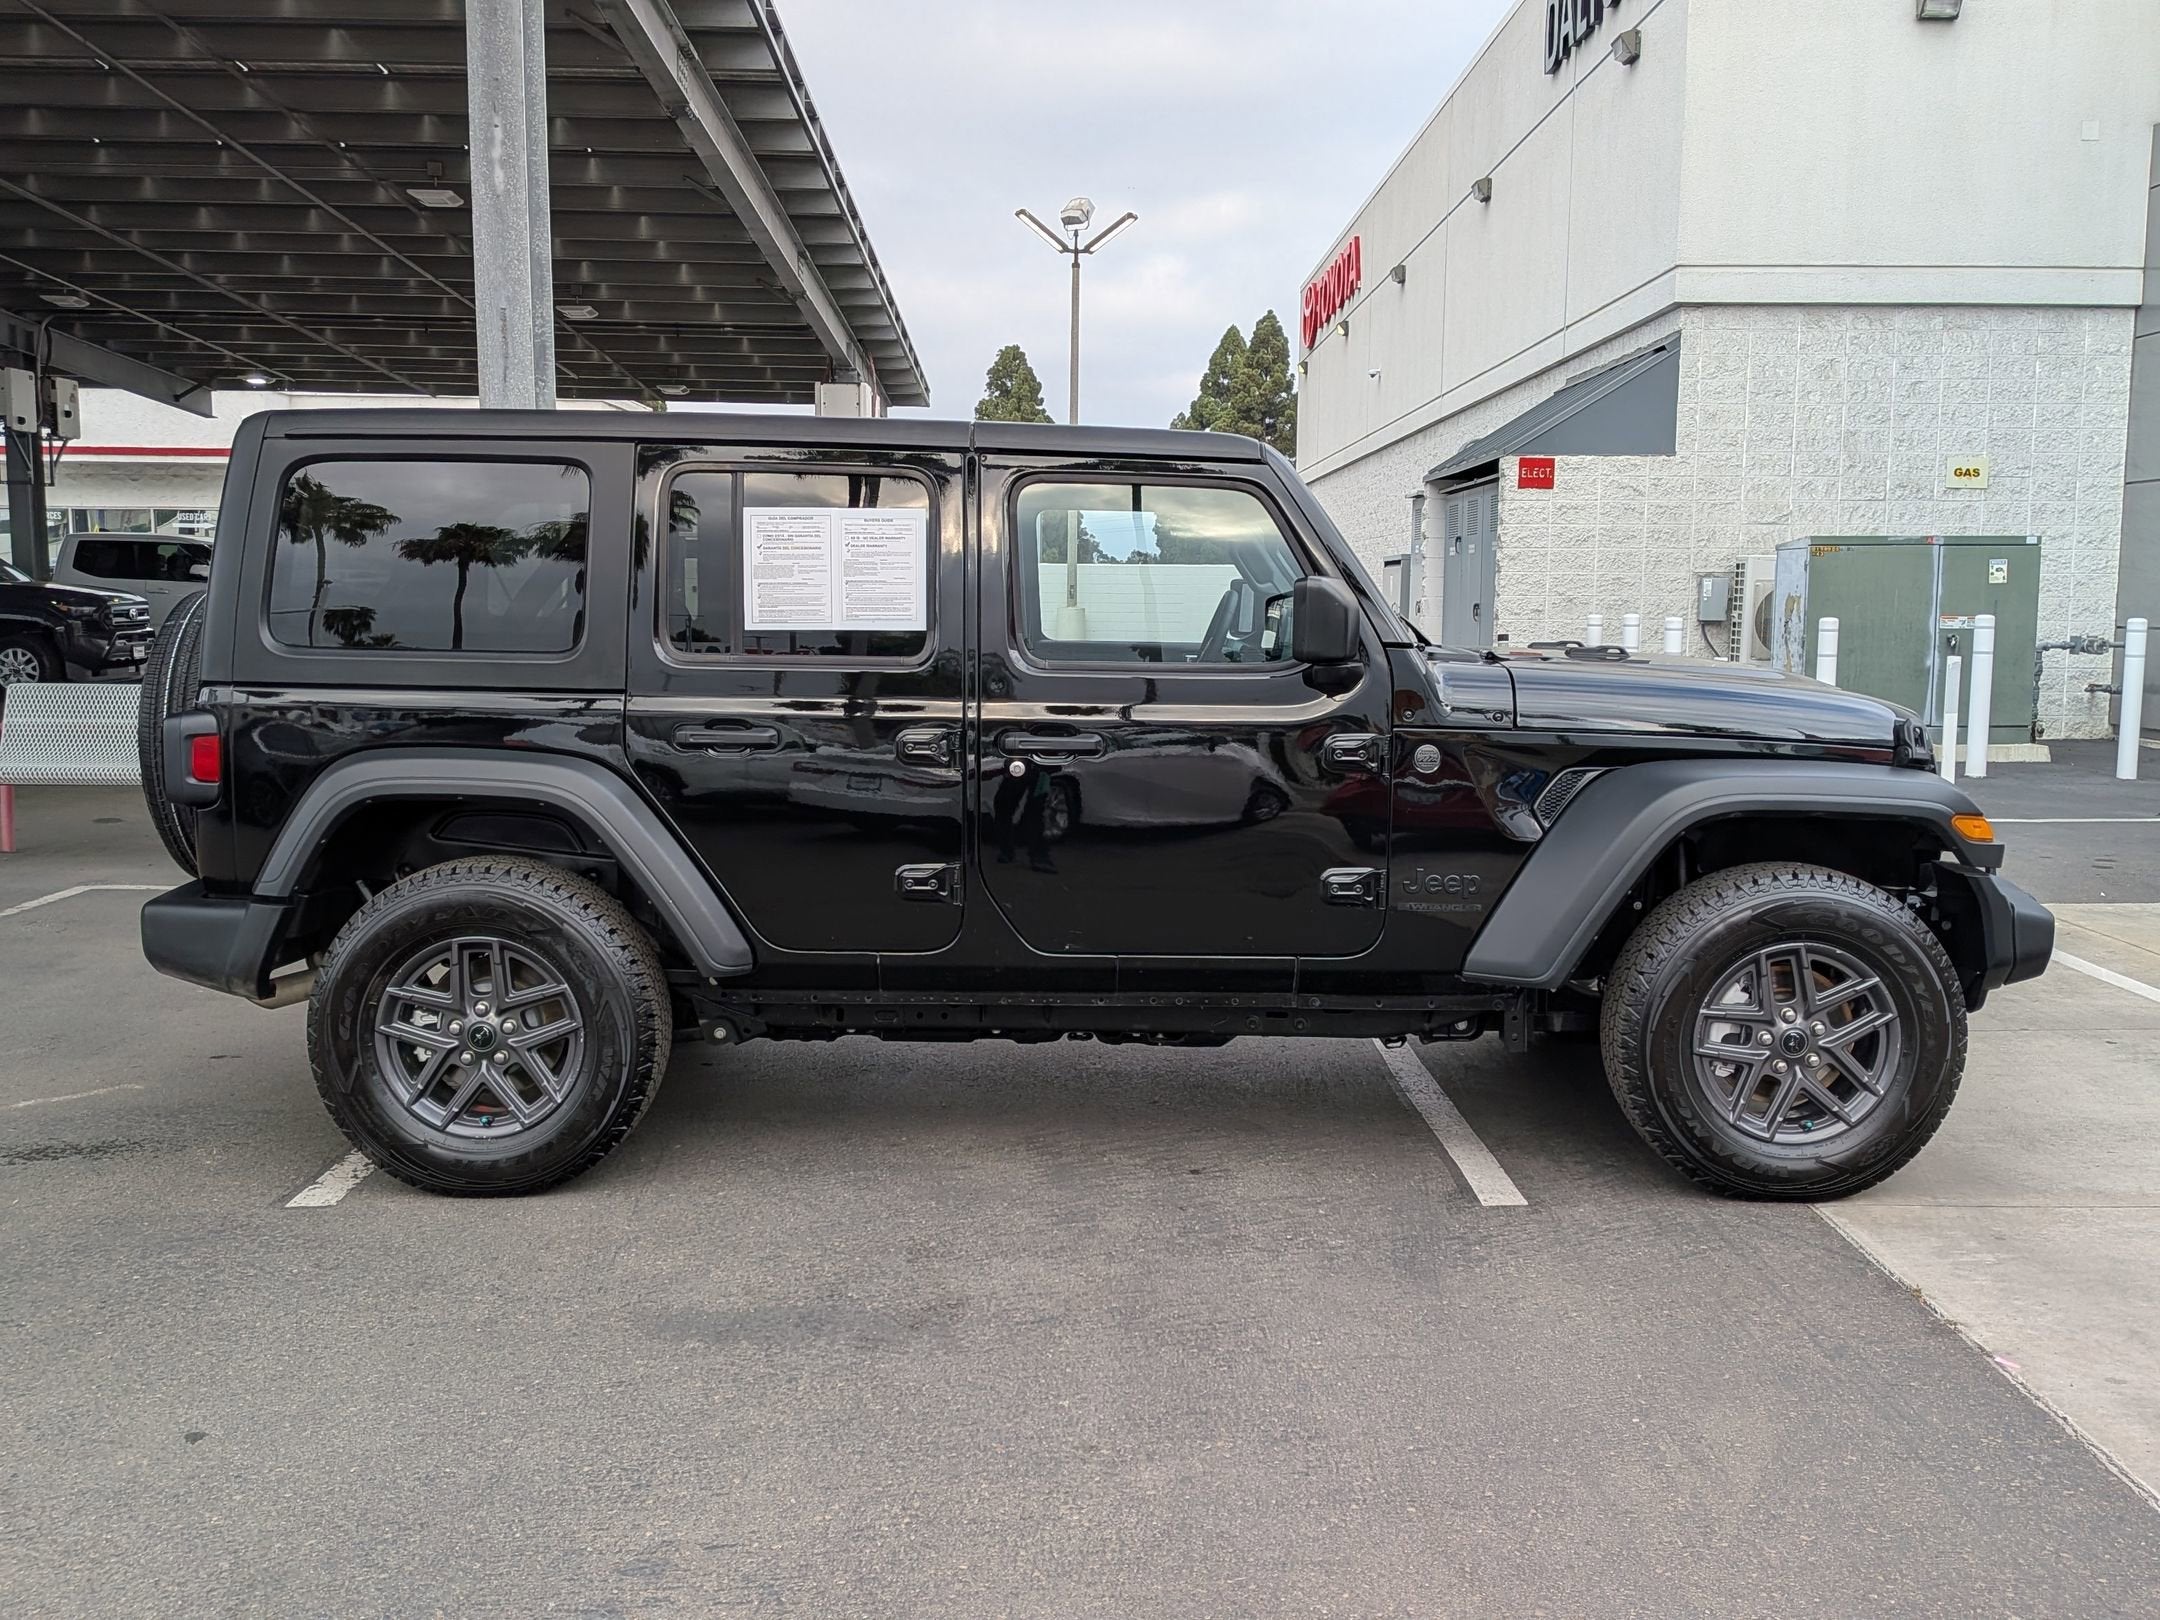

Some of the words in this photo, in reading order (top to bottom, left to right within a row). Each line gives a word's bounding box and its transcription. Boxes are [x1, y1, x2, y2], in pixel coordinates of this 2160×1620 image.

[1316, 236, 1361, 329] TOYOTA
[1521, 467, 1553, 479] ELECT.
[1953, 467, 1981, 478] GAS
[178, 512, 194, 522] USED
[1402, 865, 1481, 900] Jeep
